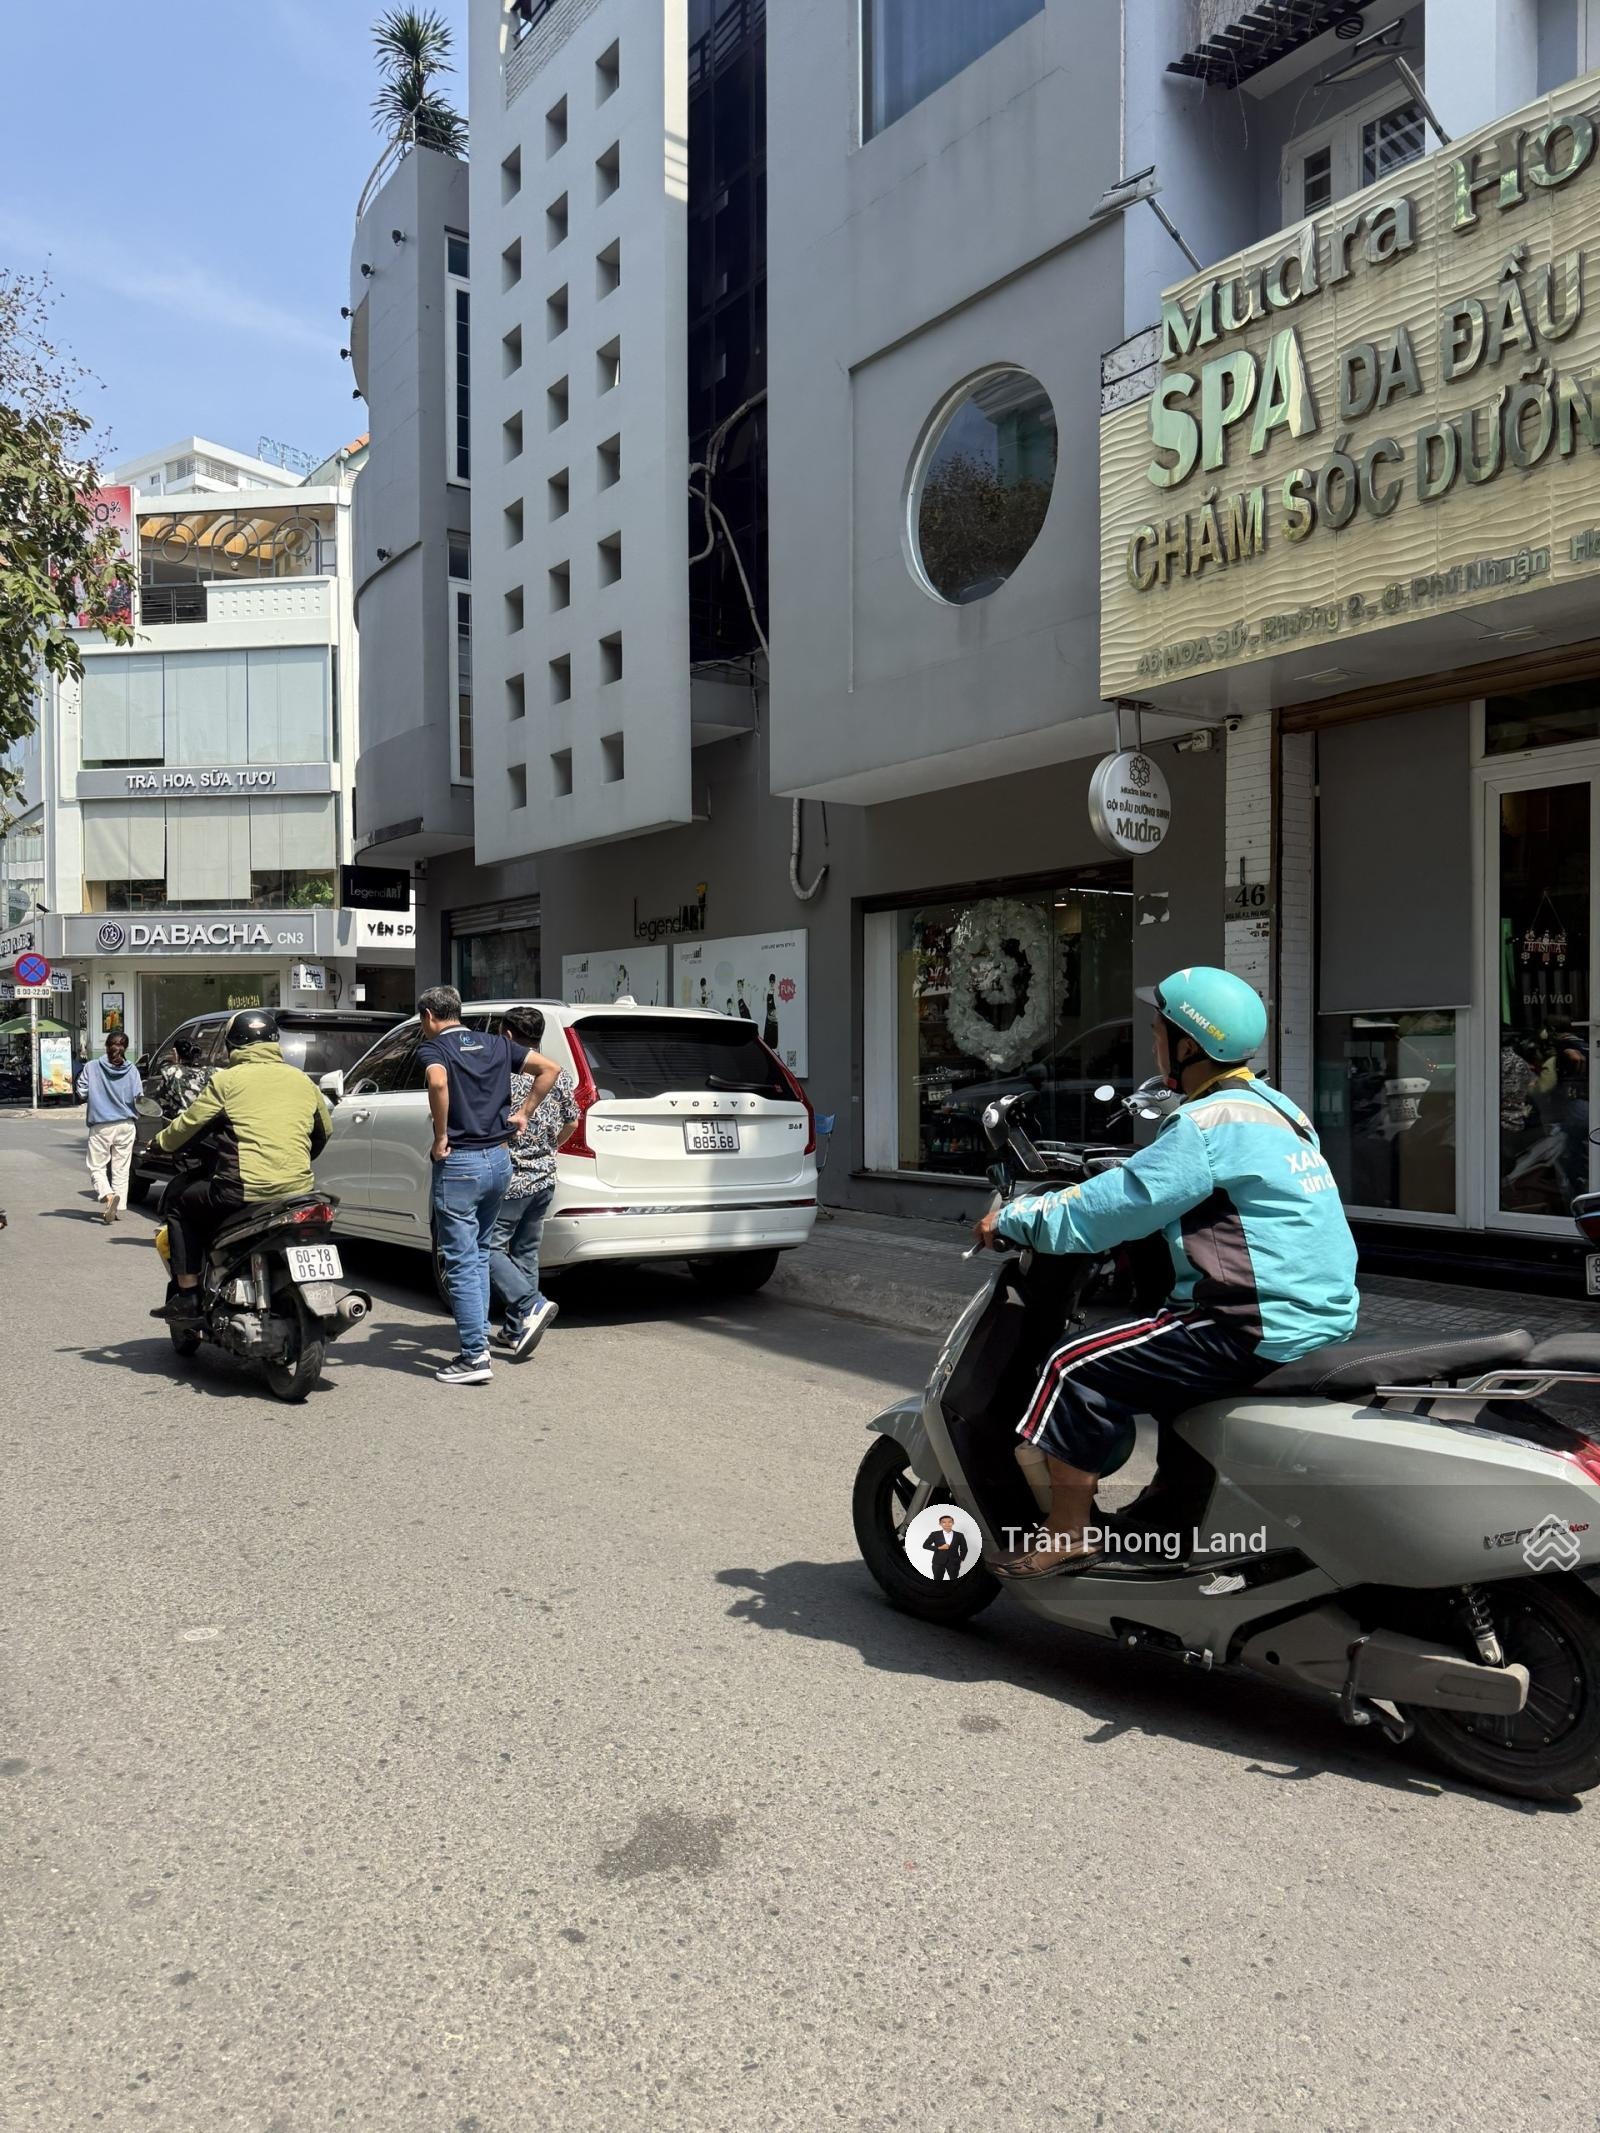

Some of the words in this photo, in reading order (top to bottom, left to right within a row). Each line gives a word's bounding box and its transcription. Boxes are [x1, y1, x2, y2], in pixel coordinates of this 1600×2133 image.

[1160, 196, 1416, 364] Mudra
[1146, 325, 1318, 490] SPA
[1339, 324, 1422, 422] DA
[1125, 486, 1266, 592] CHĂM
[1280, 432, 1405, 544] SÓC
[1136, 649, 1160, 676] 46
[1162, 636, 1213, 672] HOA
[1464, 545, 1552, 592] Nhuận
[127, 771, 159, 789] TRÀ
[163, 773, 197, 788] HOA
[200, 768, 233, 787] SỮA
[237, 771, 276, 786] TƯƠI
[1116, 817, 1161, 842] Mudra
[1235, 884, 1266, 908] 46
[130, 923, 273, 946] DABACHA
[277, 932, 304, 945] CN3
[780, 984, 795, 994] FUN
[669, 1100, 756, 1108] VOLVO
[701, 1121, 724, 1135] 51L
[295, 1248, 331, 1264] 60-Y8
[298, 1263, 335, 1279] 0640
